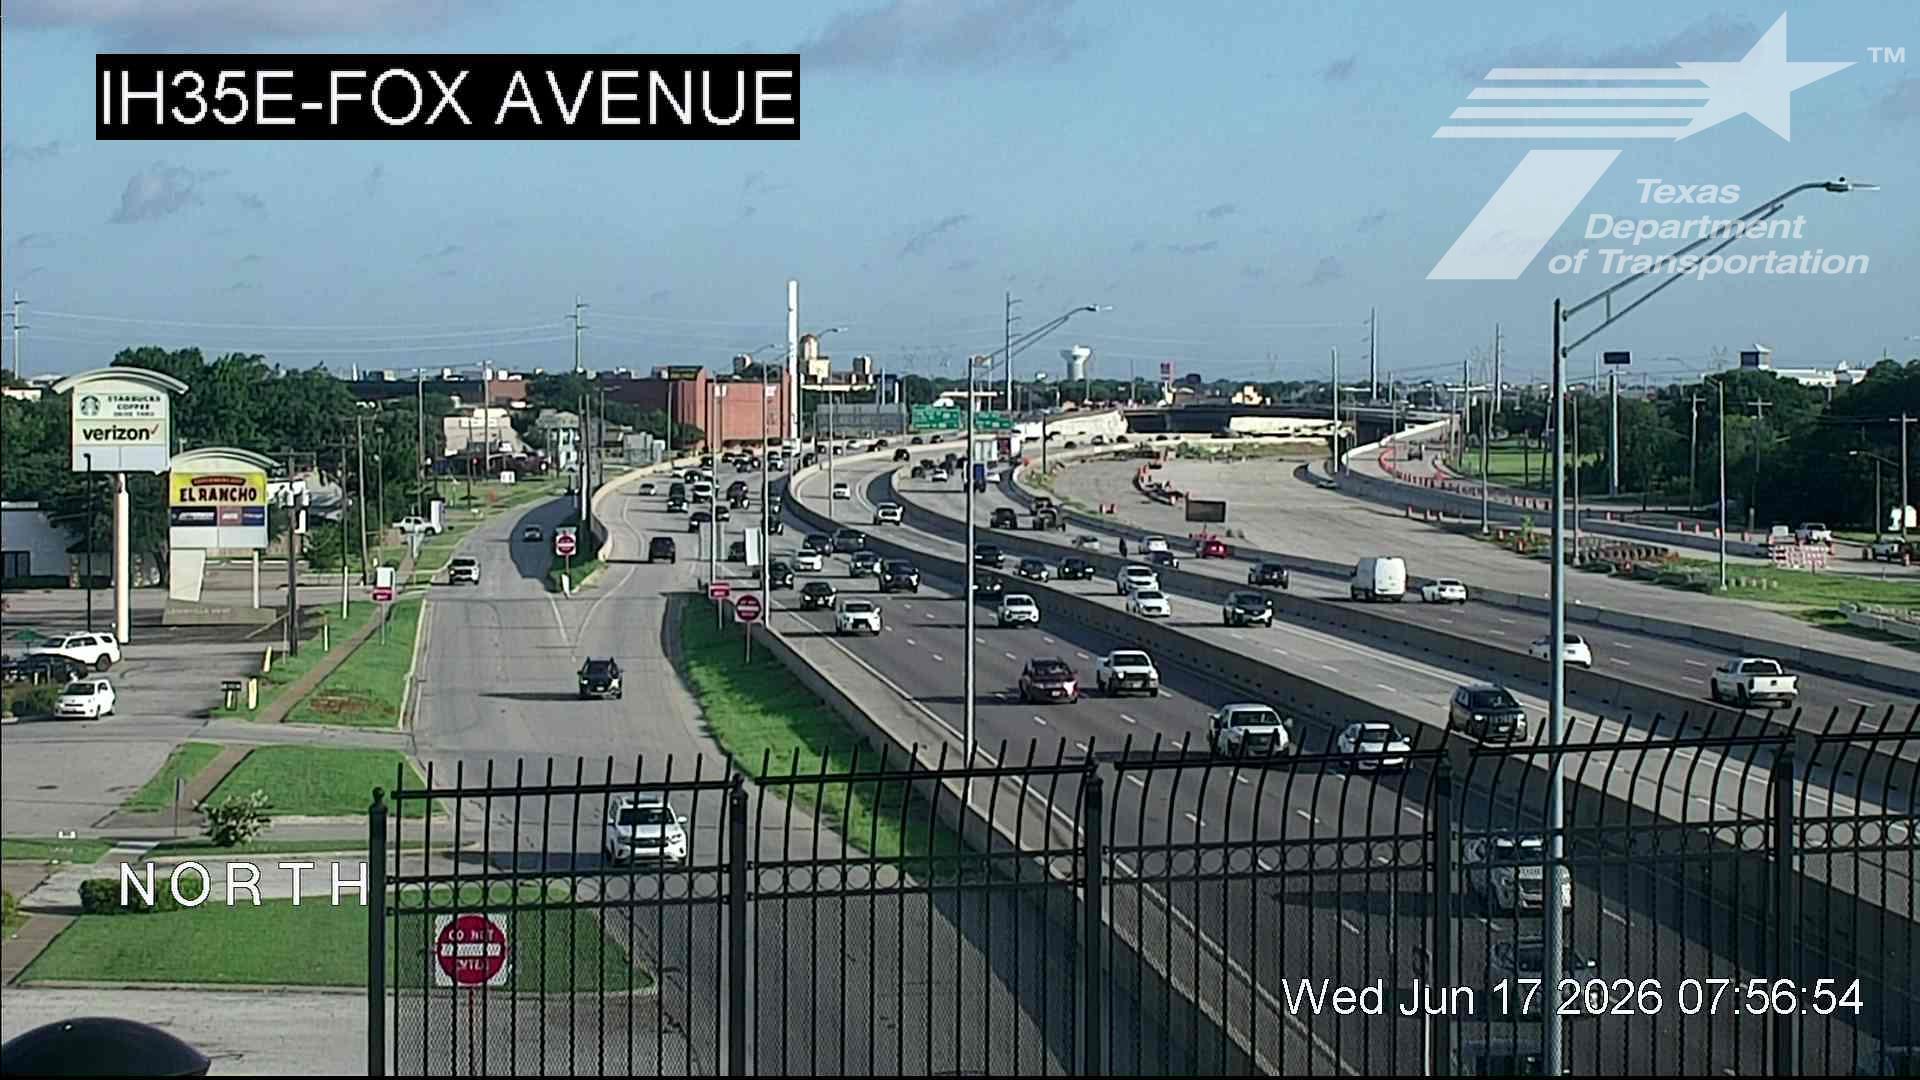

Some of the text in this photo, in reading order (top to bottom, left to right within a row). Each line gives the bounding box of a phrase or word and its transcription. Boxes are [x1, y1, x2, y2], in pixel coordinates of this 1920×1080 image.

[82, 424, 150, 441] verizon
[180, 487, 257, 502] EL RANCHO
